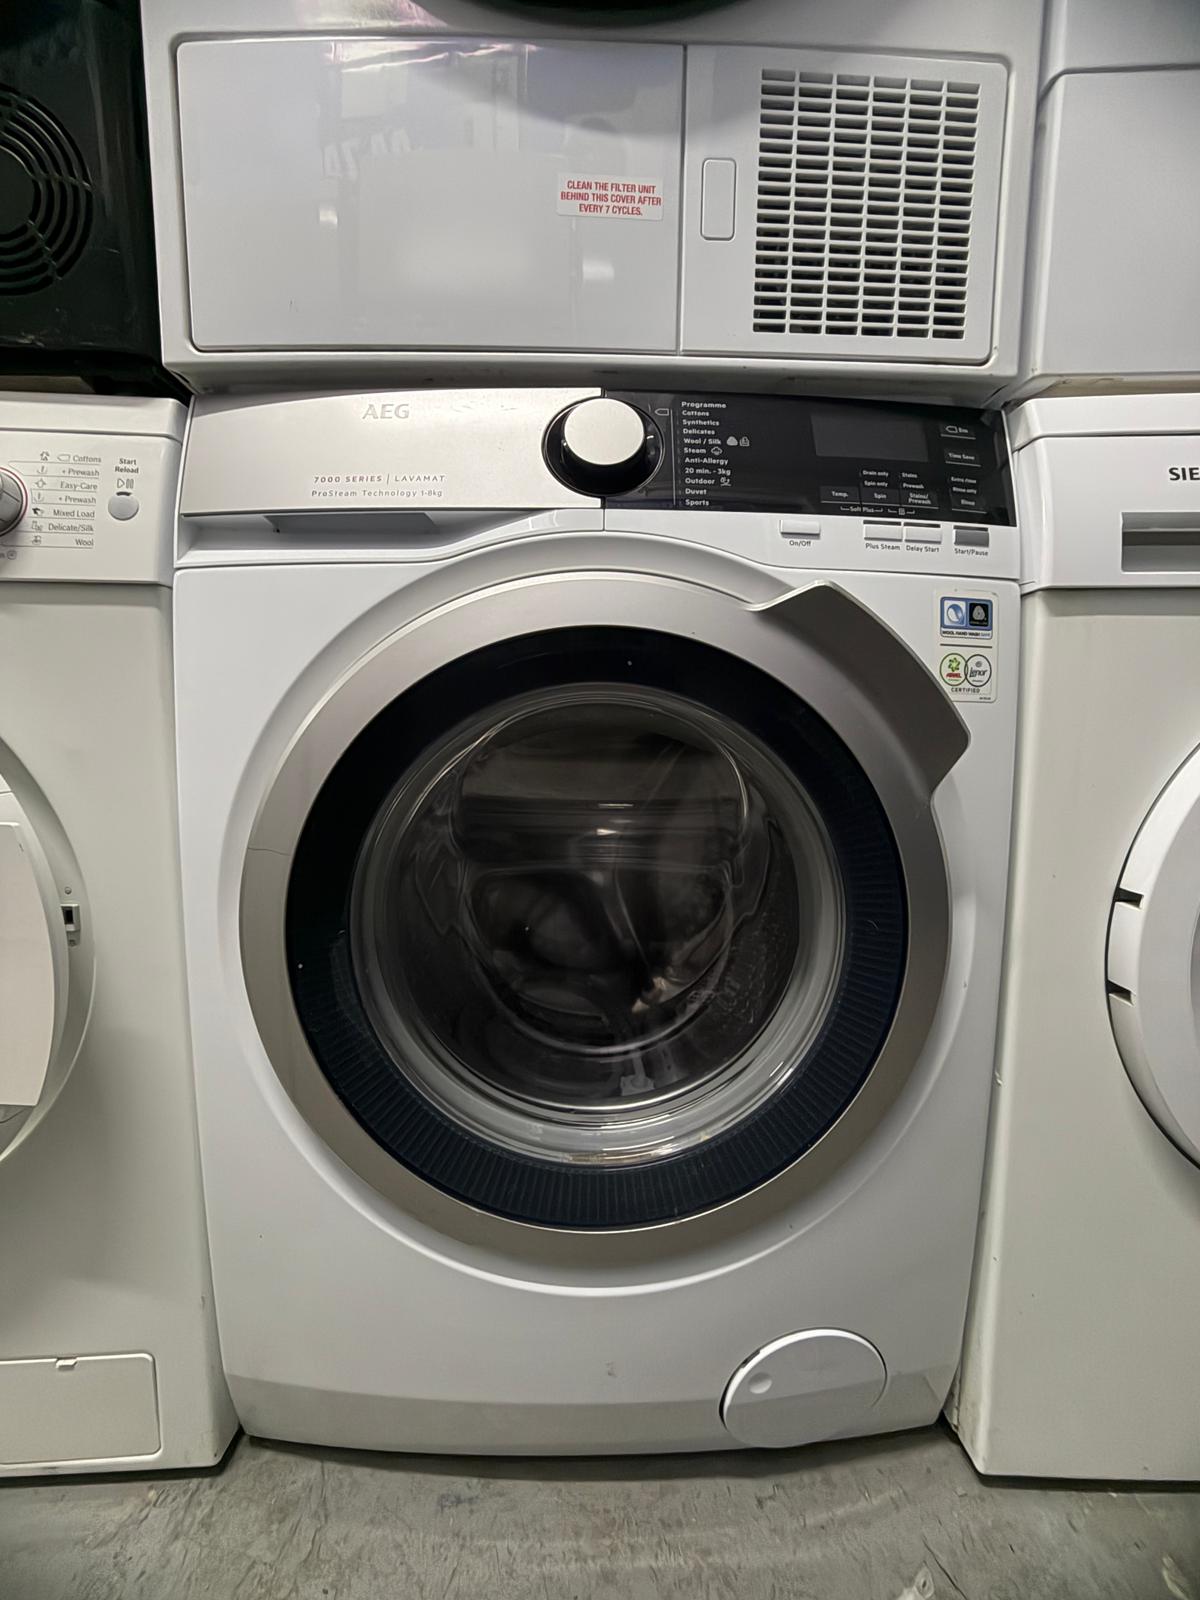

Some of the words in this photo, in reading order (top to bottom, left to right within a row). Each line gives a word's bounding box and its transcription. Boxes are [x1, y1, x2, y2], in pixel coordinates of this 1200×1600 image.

[567, 180, 592, 190] CLEAN
[594, 182, 609, 191] THE
[610, 183, 637, 193] FILTER
[638, 184, 656, 194] UNIT
[560, 191, 589, 201] BEHIND
[591, 193, 609, 202] THIS
[610, 194, 636, 204] COVER
[637, 195, 662, 206] AFTER
[579, 203, 604, 213] EVERY
[605, 205, 610, 214] 7
[612, 206, 643, 216] CYCLES.
[681, 401, 727, 409] Programme
[362, 403, 410, 419] AEG
[682, 419, 720, 428] Synthetics
[72, 455, 102, 463] Cottons
[685, 457, 729, 466] Anti-Allergy
[68, 468, 100, 477] Prewash
[115, 466, 139, 474] Reload
[717, 468, 731, 476] 3kg
[394, 475, 445, 483] LAVAMAT
[60, 481, 98, 490] Easy-Care
[362, 489, 417, 498] Technology
[64, 495, 97, 504] Prewash
[685, 499, 710, 507] Sports
[53, 509, 74, 517] Mixed
[76, 510, 95, 518] Load
[48, 523, 94, 532] Delicate/Silk
[75, 538, 94, 546] Wool
[880, 543, 901, 551] Steam
[906, 545, 923, 553] Delay
[954, 548, 989, 557] Start/Pause
